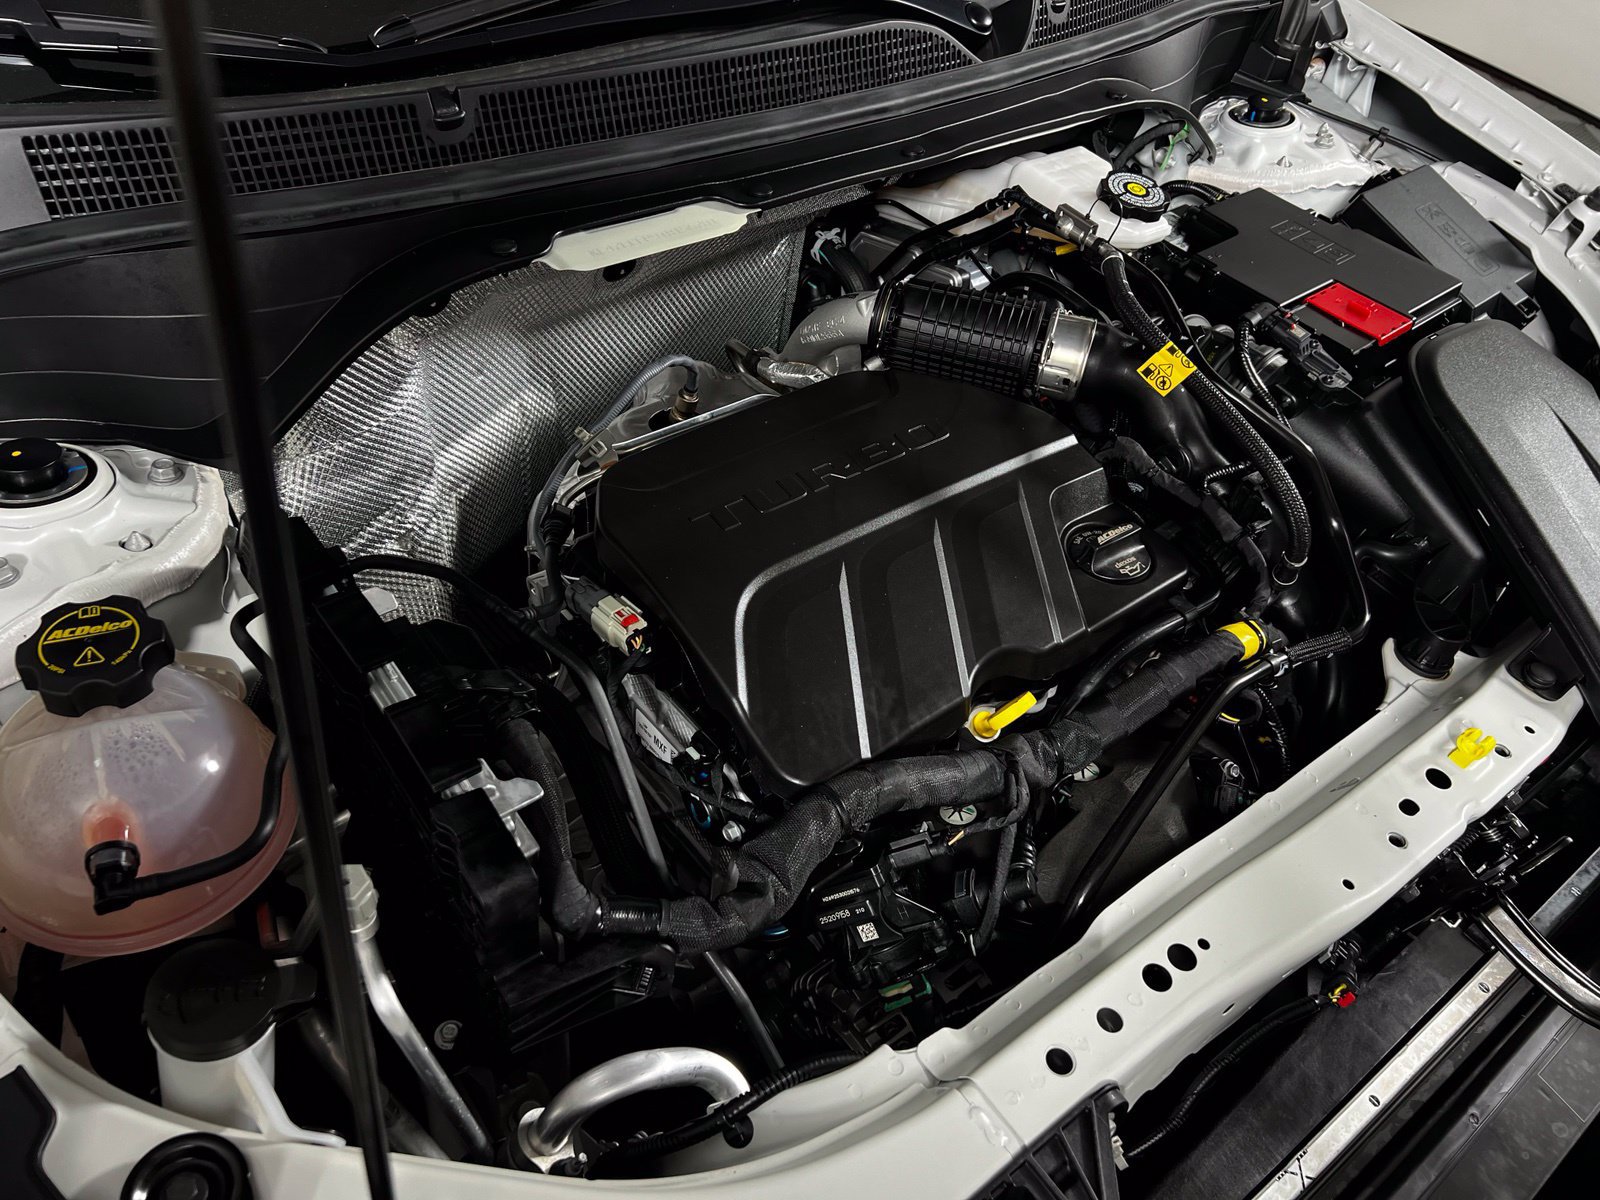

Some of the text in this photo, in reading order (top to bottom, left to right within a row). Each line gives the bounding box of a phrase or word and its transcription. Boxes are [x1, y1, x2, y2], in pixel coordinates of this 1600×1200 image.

[688, 424, 951, 531] TURBO
[1097, 524, 1133, 543] ACDelco
[1115, 556, 1136, 569] dexos
[47, 619, 133, 640] ACDelco
[819, 909, 851, 925] 25209158
